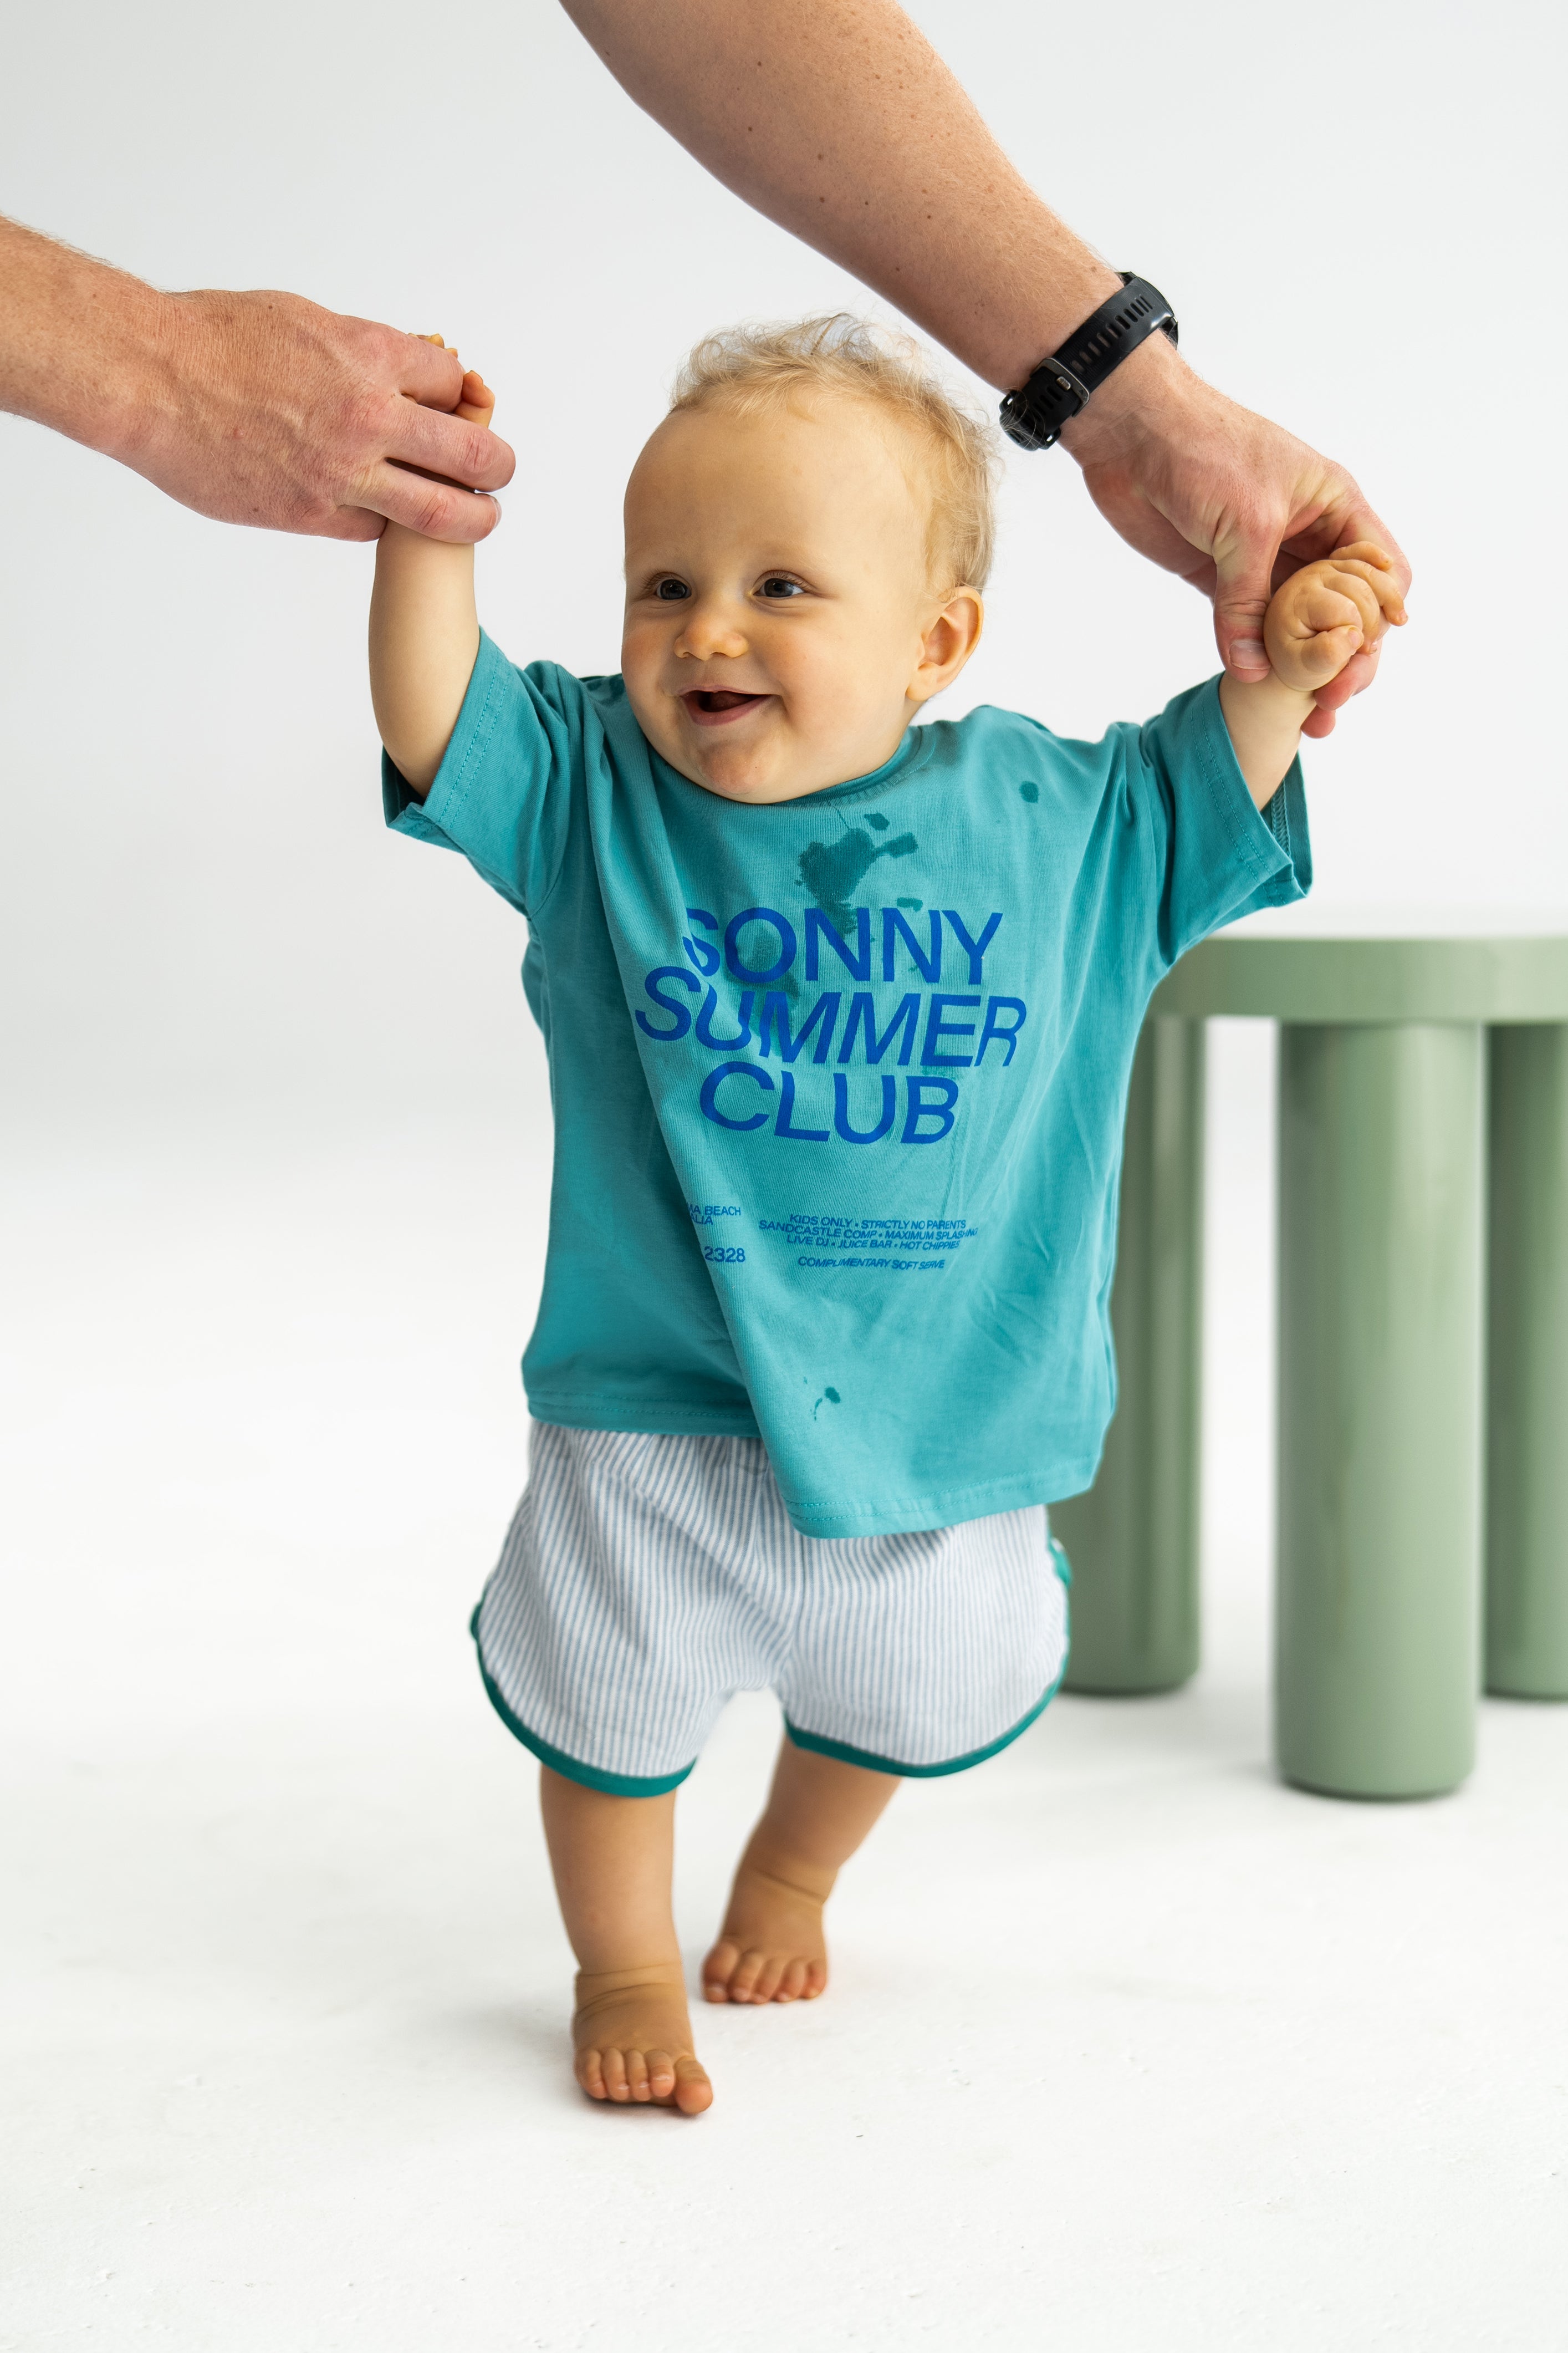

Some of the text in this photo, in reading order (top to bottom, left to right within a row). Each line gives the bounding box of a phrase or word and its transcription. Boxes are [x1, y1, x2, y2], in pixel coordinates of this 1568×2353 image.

[682, 907, 1003, 985] SONNY
[635, 966, 1027, 1067] SUMMER
[699, 1061, 959, 1144] CLUB
[705, 1205, 741, 1216] BEACH
[759, 1220, 841, 1237] SANDCASTLE
[844, 1229, 877, 1239] COMP
[885, 1230, 934, 1240] MAXIMUM
[790, 1214, 966, 1230] KIDS ONLY STRICTLY NO PARENTS
[787, 1235, 961, 1251] LIVE DJ JUICE BAR HOT CHIPPIES
[704, 1246, 745, 1263] 2328
[798, 1256, 946, 1270] COMPLIMENTARY SOFT SERVE
